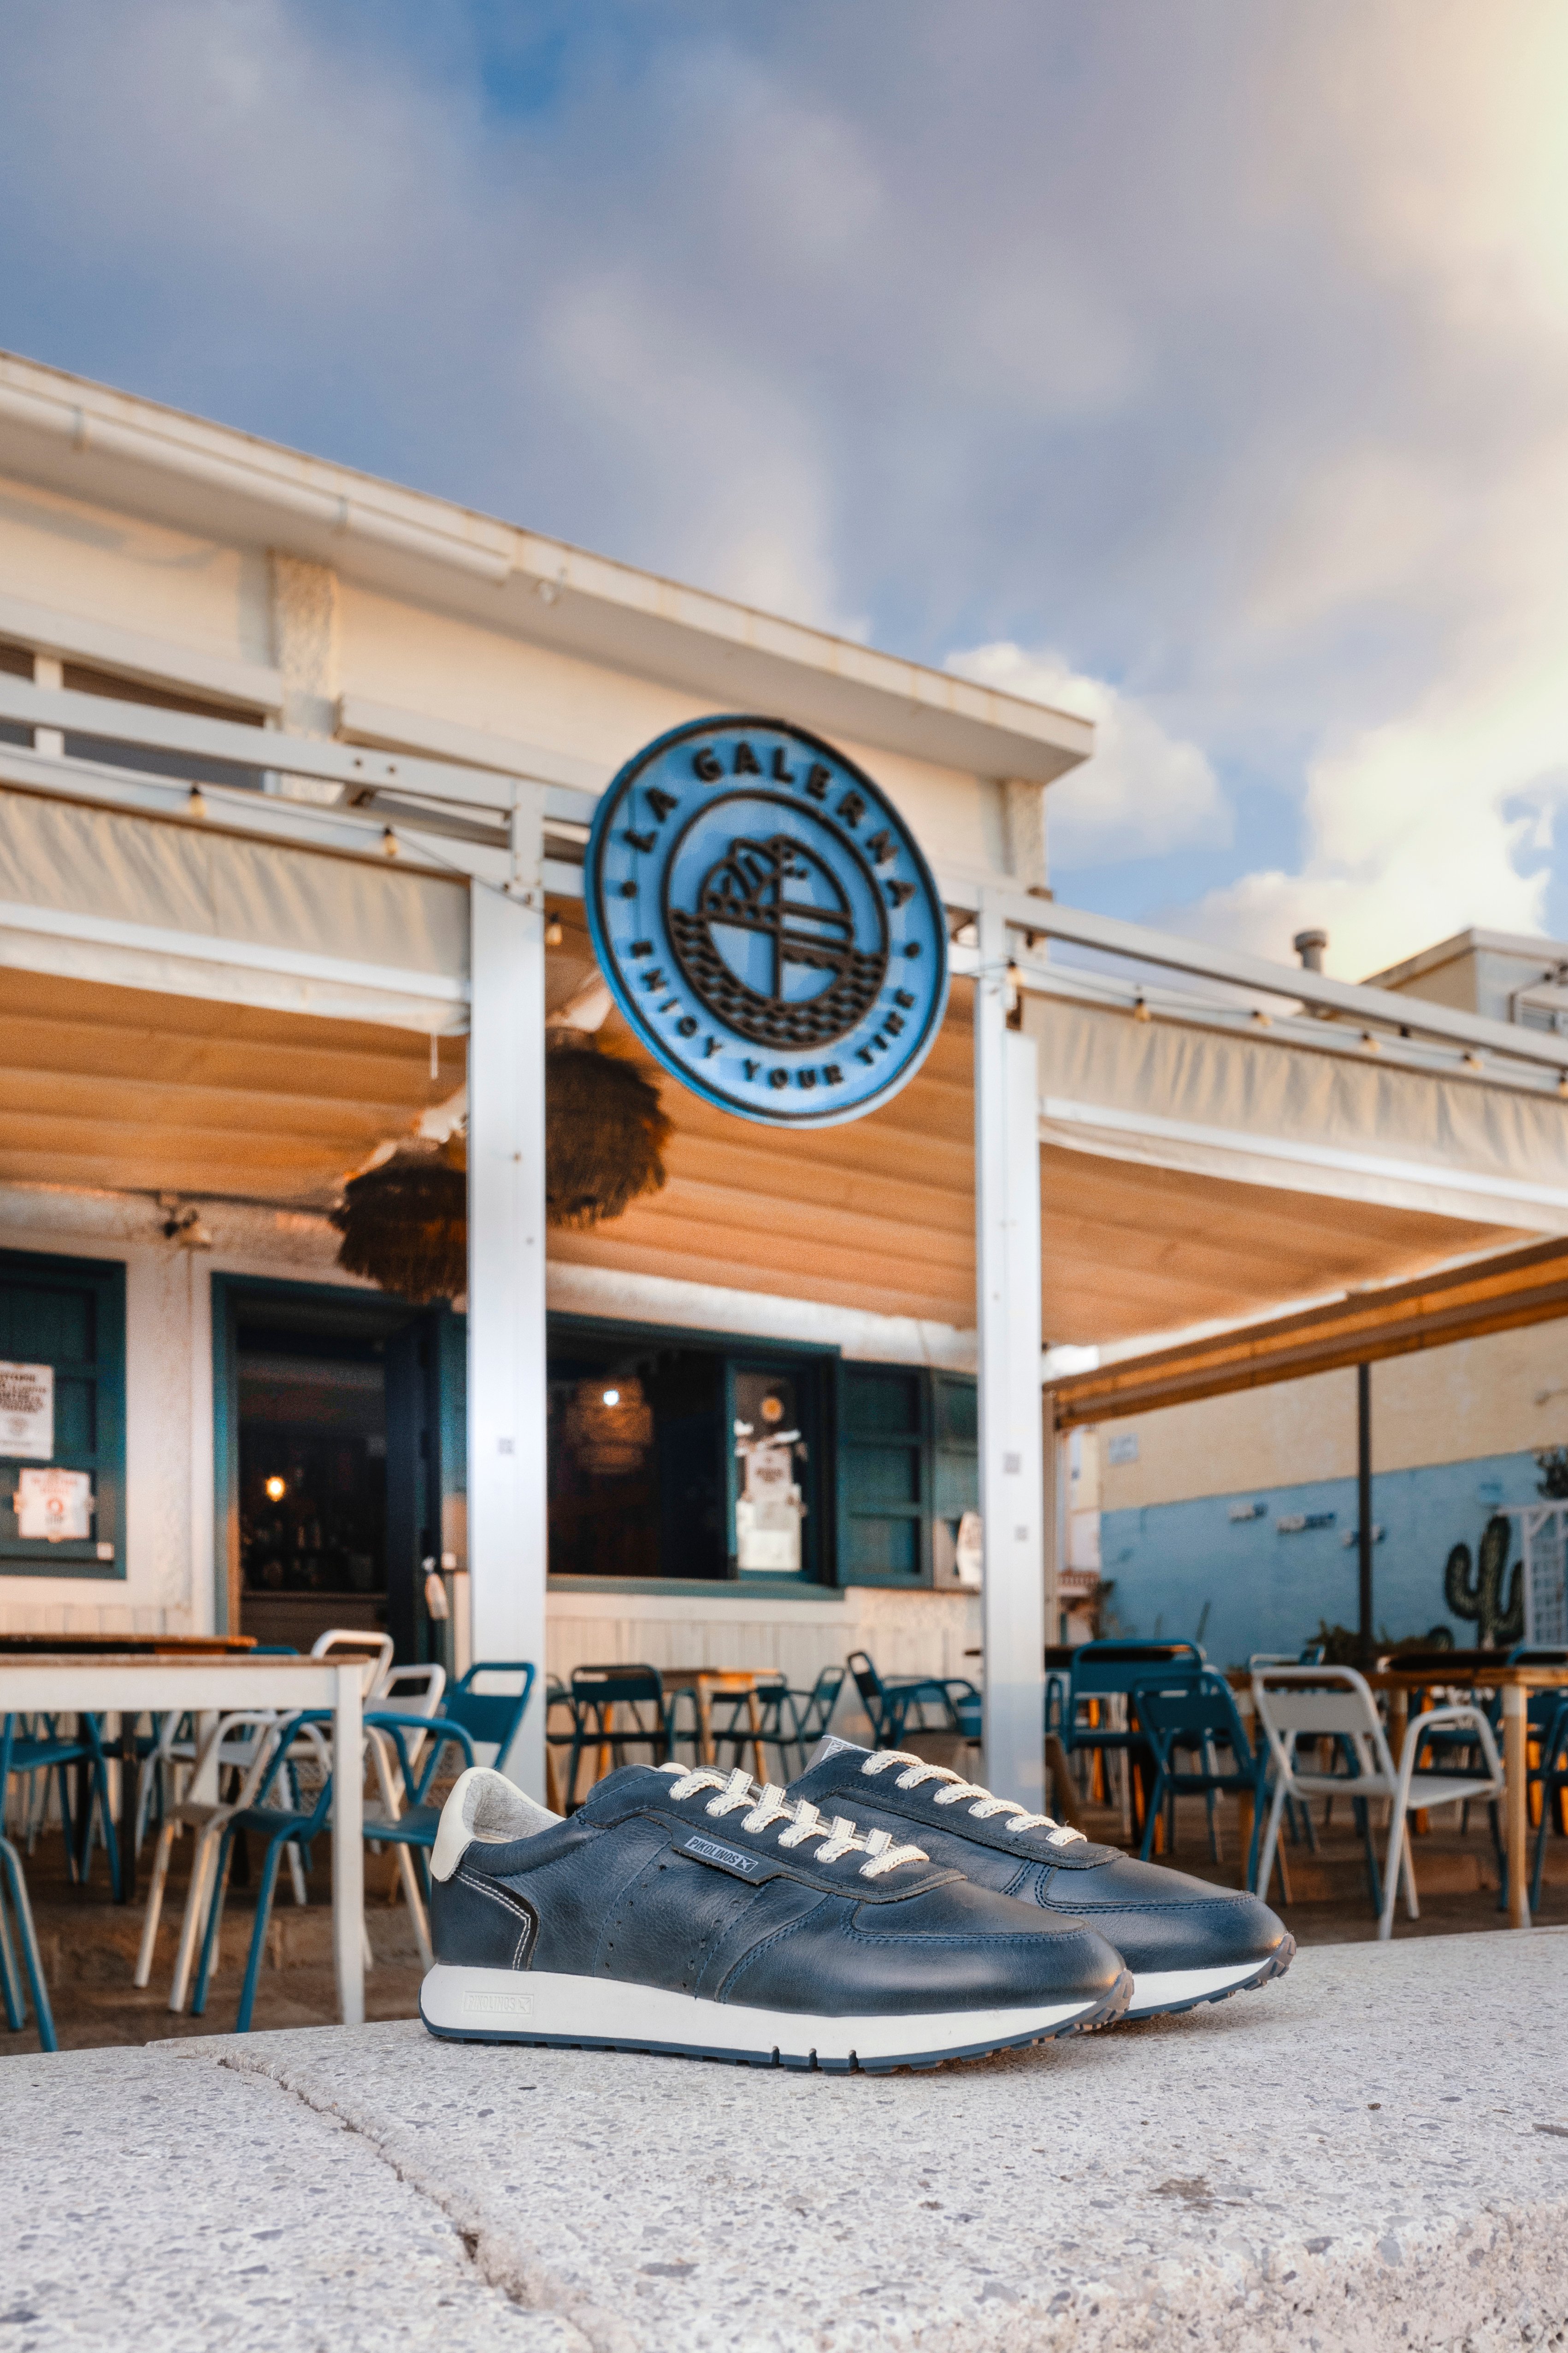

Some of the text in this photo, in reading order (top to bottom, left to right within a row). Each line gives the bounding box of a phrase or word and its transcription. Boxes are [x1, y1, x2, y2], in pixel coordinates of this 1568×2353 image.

[624, 741, 917, 908] LA GALERNA
[631, 940, 915, 1090] ENJOY YOUR TIME
[688, 1839, 739, 1864] PIKOLINOS
[468, 1995, 516, 2010] PIKOLINOS
